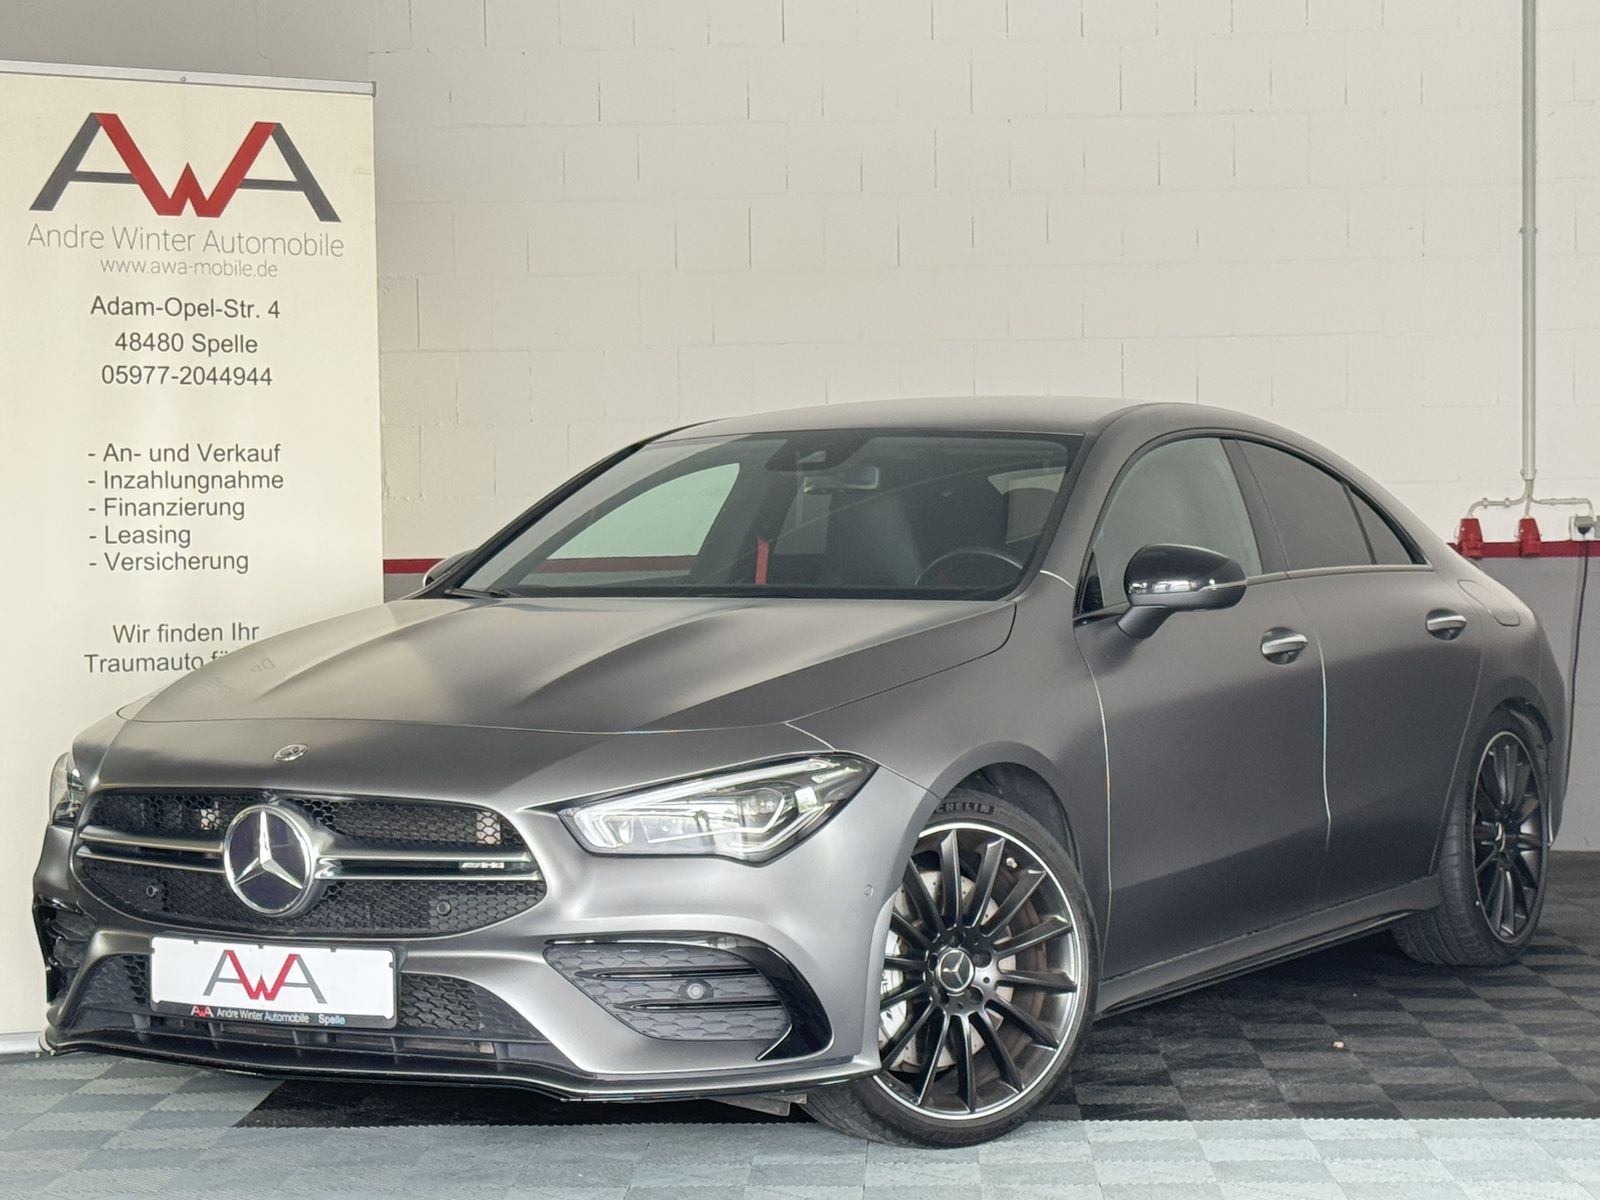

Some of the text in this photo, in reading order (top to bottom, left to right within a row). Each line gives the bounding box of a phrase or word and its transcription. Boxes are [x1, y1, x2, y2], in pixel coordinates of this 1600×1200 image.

[27, 223, 345, 258] Andre Winter Automobile
[100, 259, 278, 278] www.awa-mobile.de
[90, 296, 281, 321] Adam-Opel-Str. 4
[114, 332, 258, 357] 48480 Spelle
[101, 364, 273, 386] 05977-2044944
[103, 443, 142, 463] An-
[149, 443, 190, 463] und
[197, 443, 282, 463] Verkauf
[103, 470, 284, 494] Inzahlungnahme
[104, 497, 246, 521] Finanzierung
[104, 525, 192, 549] Leasing
[103, 552, 249, 575] Versicherung
[112, 622, 260, 644] Wir finden Ihr
[84, 652, 204, 674] Traumauto
[216, 1007, 239, 1019] Andre
[239, 1009, 264, 1021] Winter
[264, 1011, 310, 1024] Automobile
